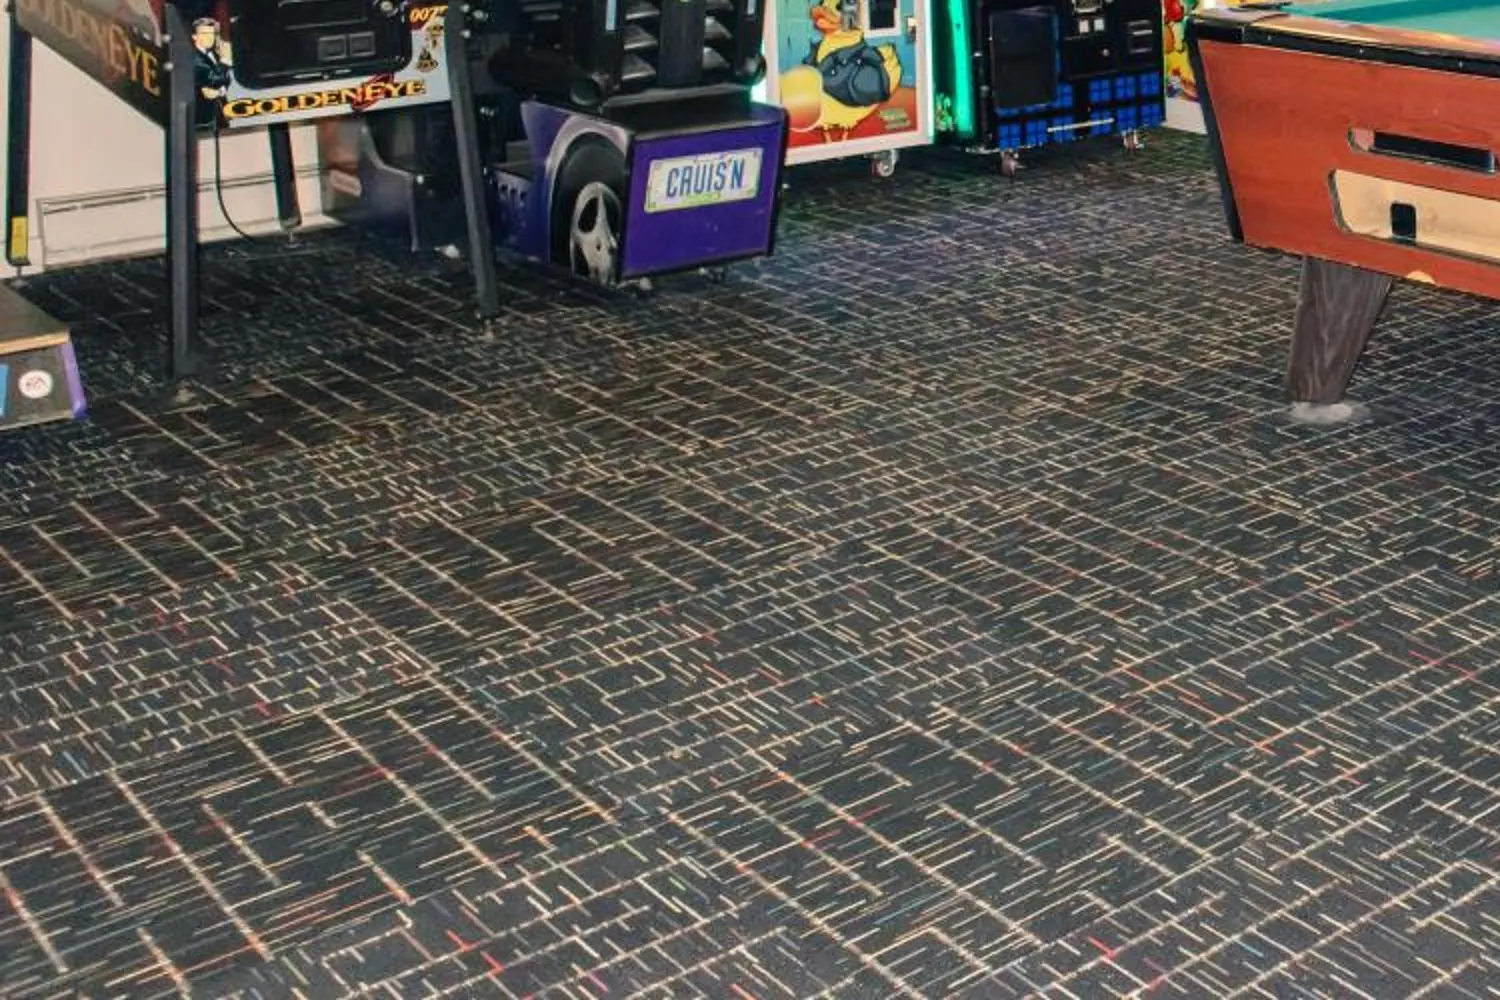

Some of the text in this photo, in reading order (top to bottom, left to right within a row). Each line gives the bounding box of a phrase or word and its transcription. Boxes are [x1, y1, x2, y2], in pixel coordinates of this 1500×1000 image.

[409, 4, 449, 24] 007
[223, 78, 428, 119] GOLDENEYE
[666, 157, 745, 198] CRUIS'N
